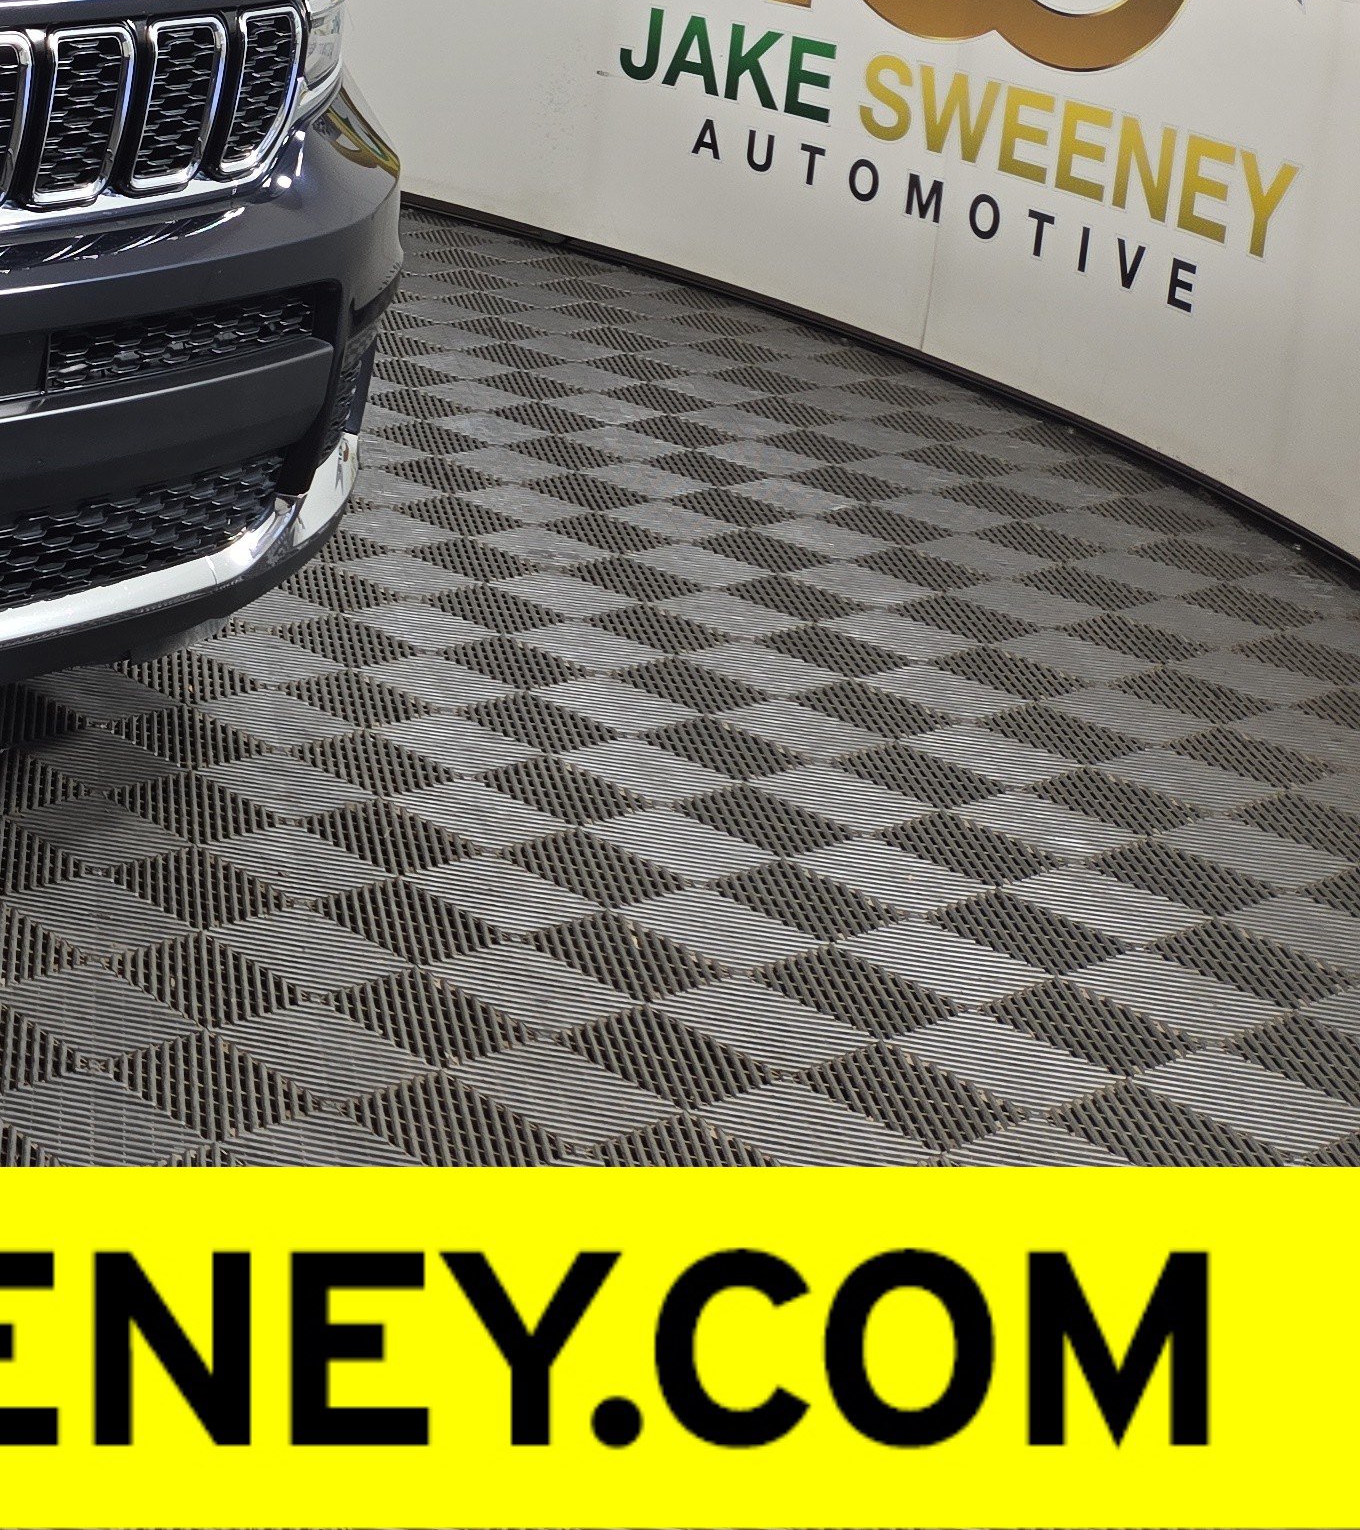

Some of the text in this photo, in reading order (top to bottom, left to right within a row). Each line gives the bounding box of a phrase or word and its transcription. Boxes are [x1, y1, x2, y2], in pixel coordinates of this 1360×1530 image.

[619, 7, 1300, 259] JAKE SWEENEY
[691, 118, 1198, 313] AUTOMOTIVE
